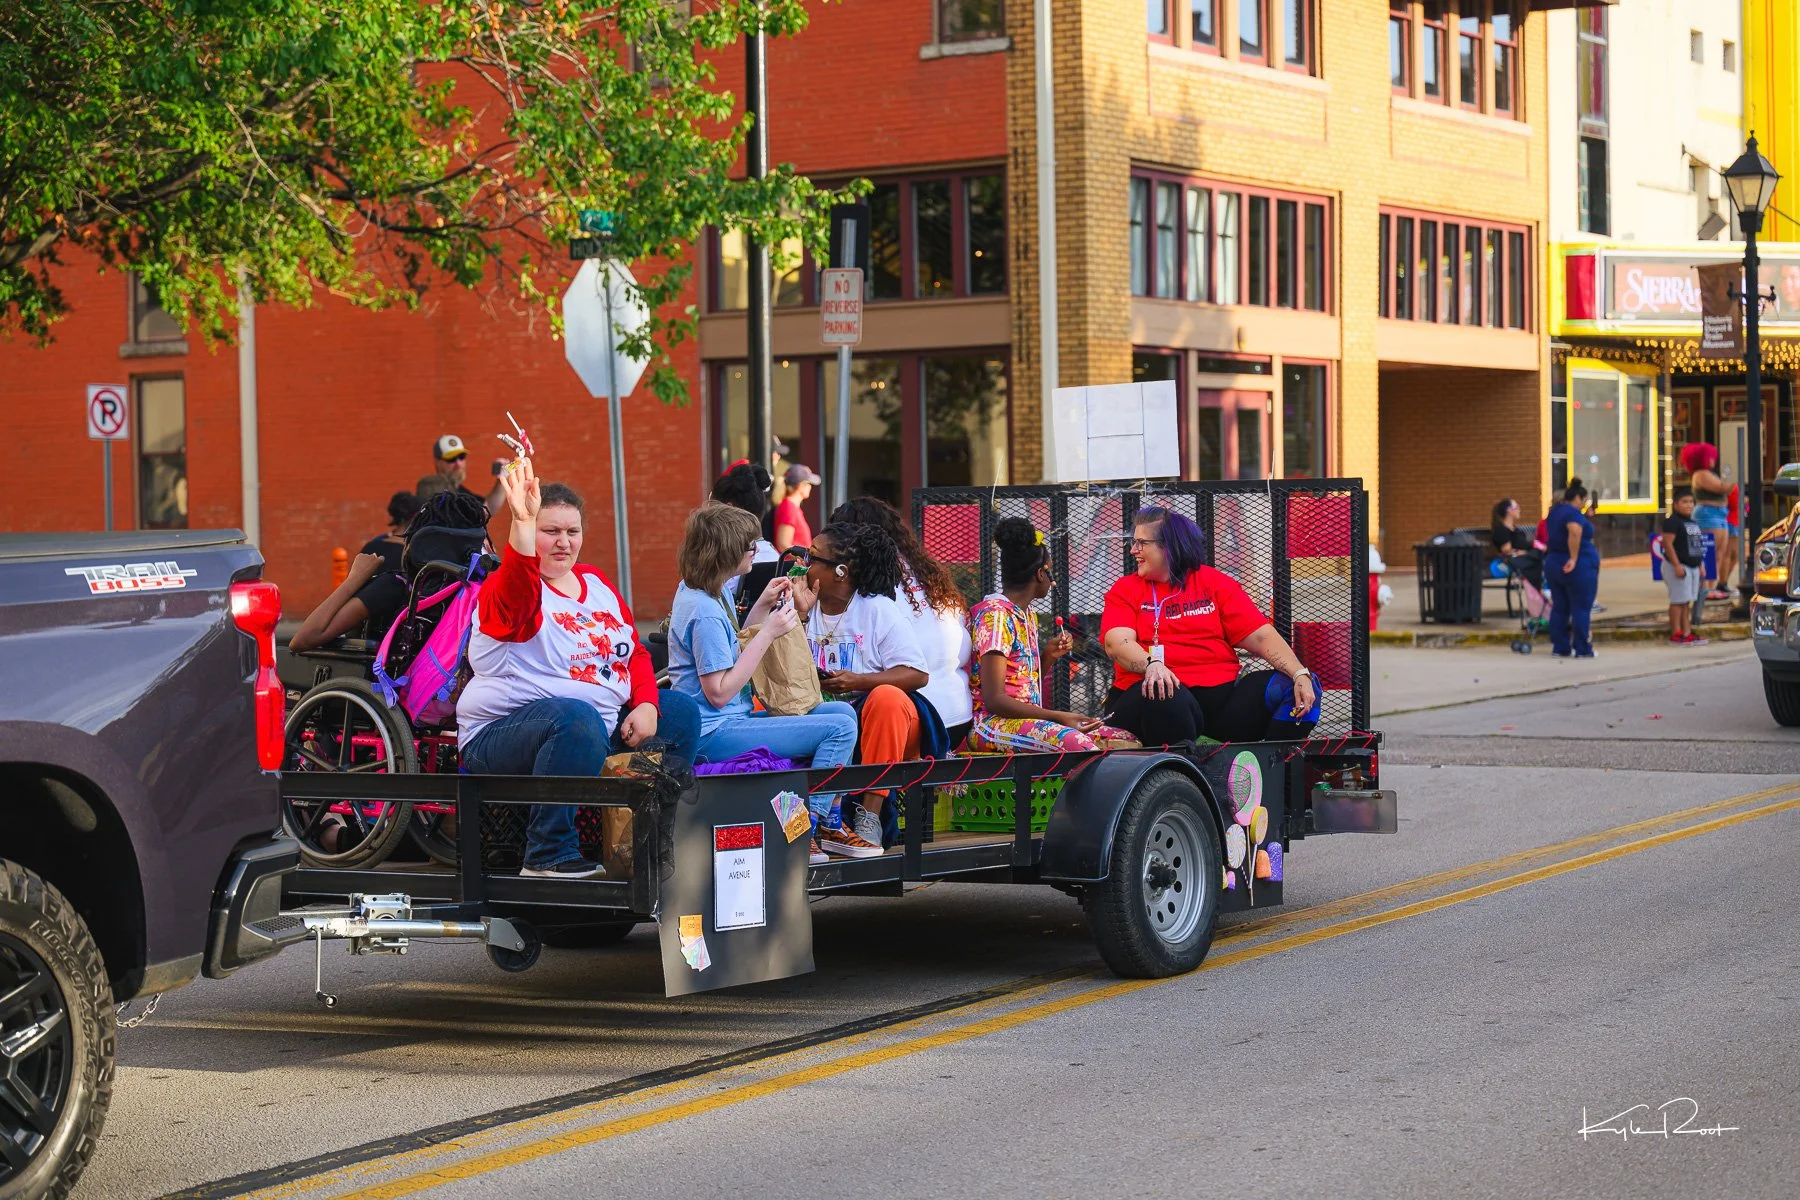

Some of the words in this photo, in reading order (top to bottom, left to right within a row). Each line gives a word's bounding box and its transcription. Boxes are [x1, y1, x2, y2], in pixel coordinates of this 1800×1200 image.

[833, 279, 850, 294] NO
[825, 300, 859, 313] REVERSE
[824, 320, 858, 334] PARKING
[65, 561, 197, 581] TRAIL
[90, 575, 186, 594] BOSS
[1166, 603, 1182, 619] RED
[1183, 599, 1215, 617] RAIDERS
[728, 870, 751, 880] AVENUE
